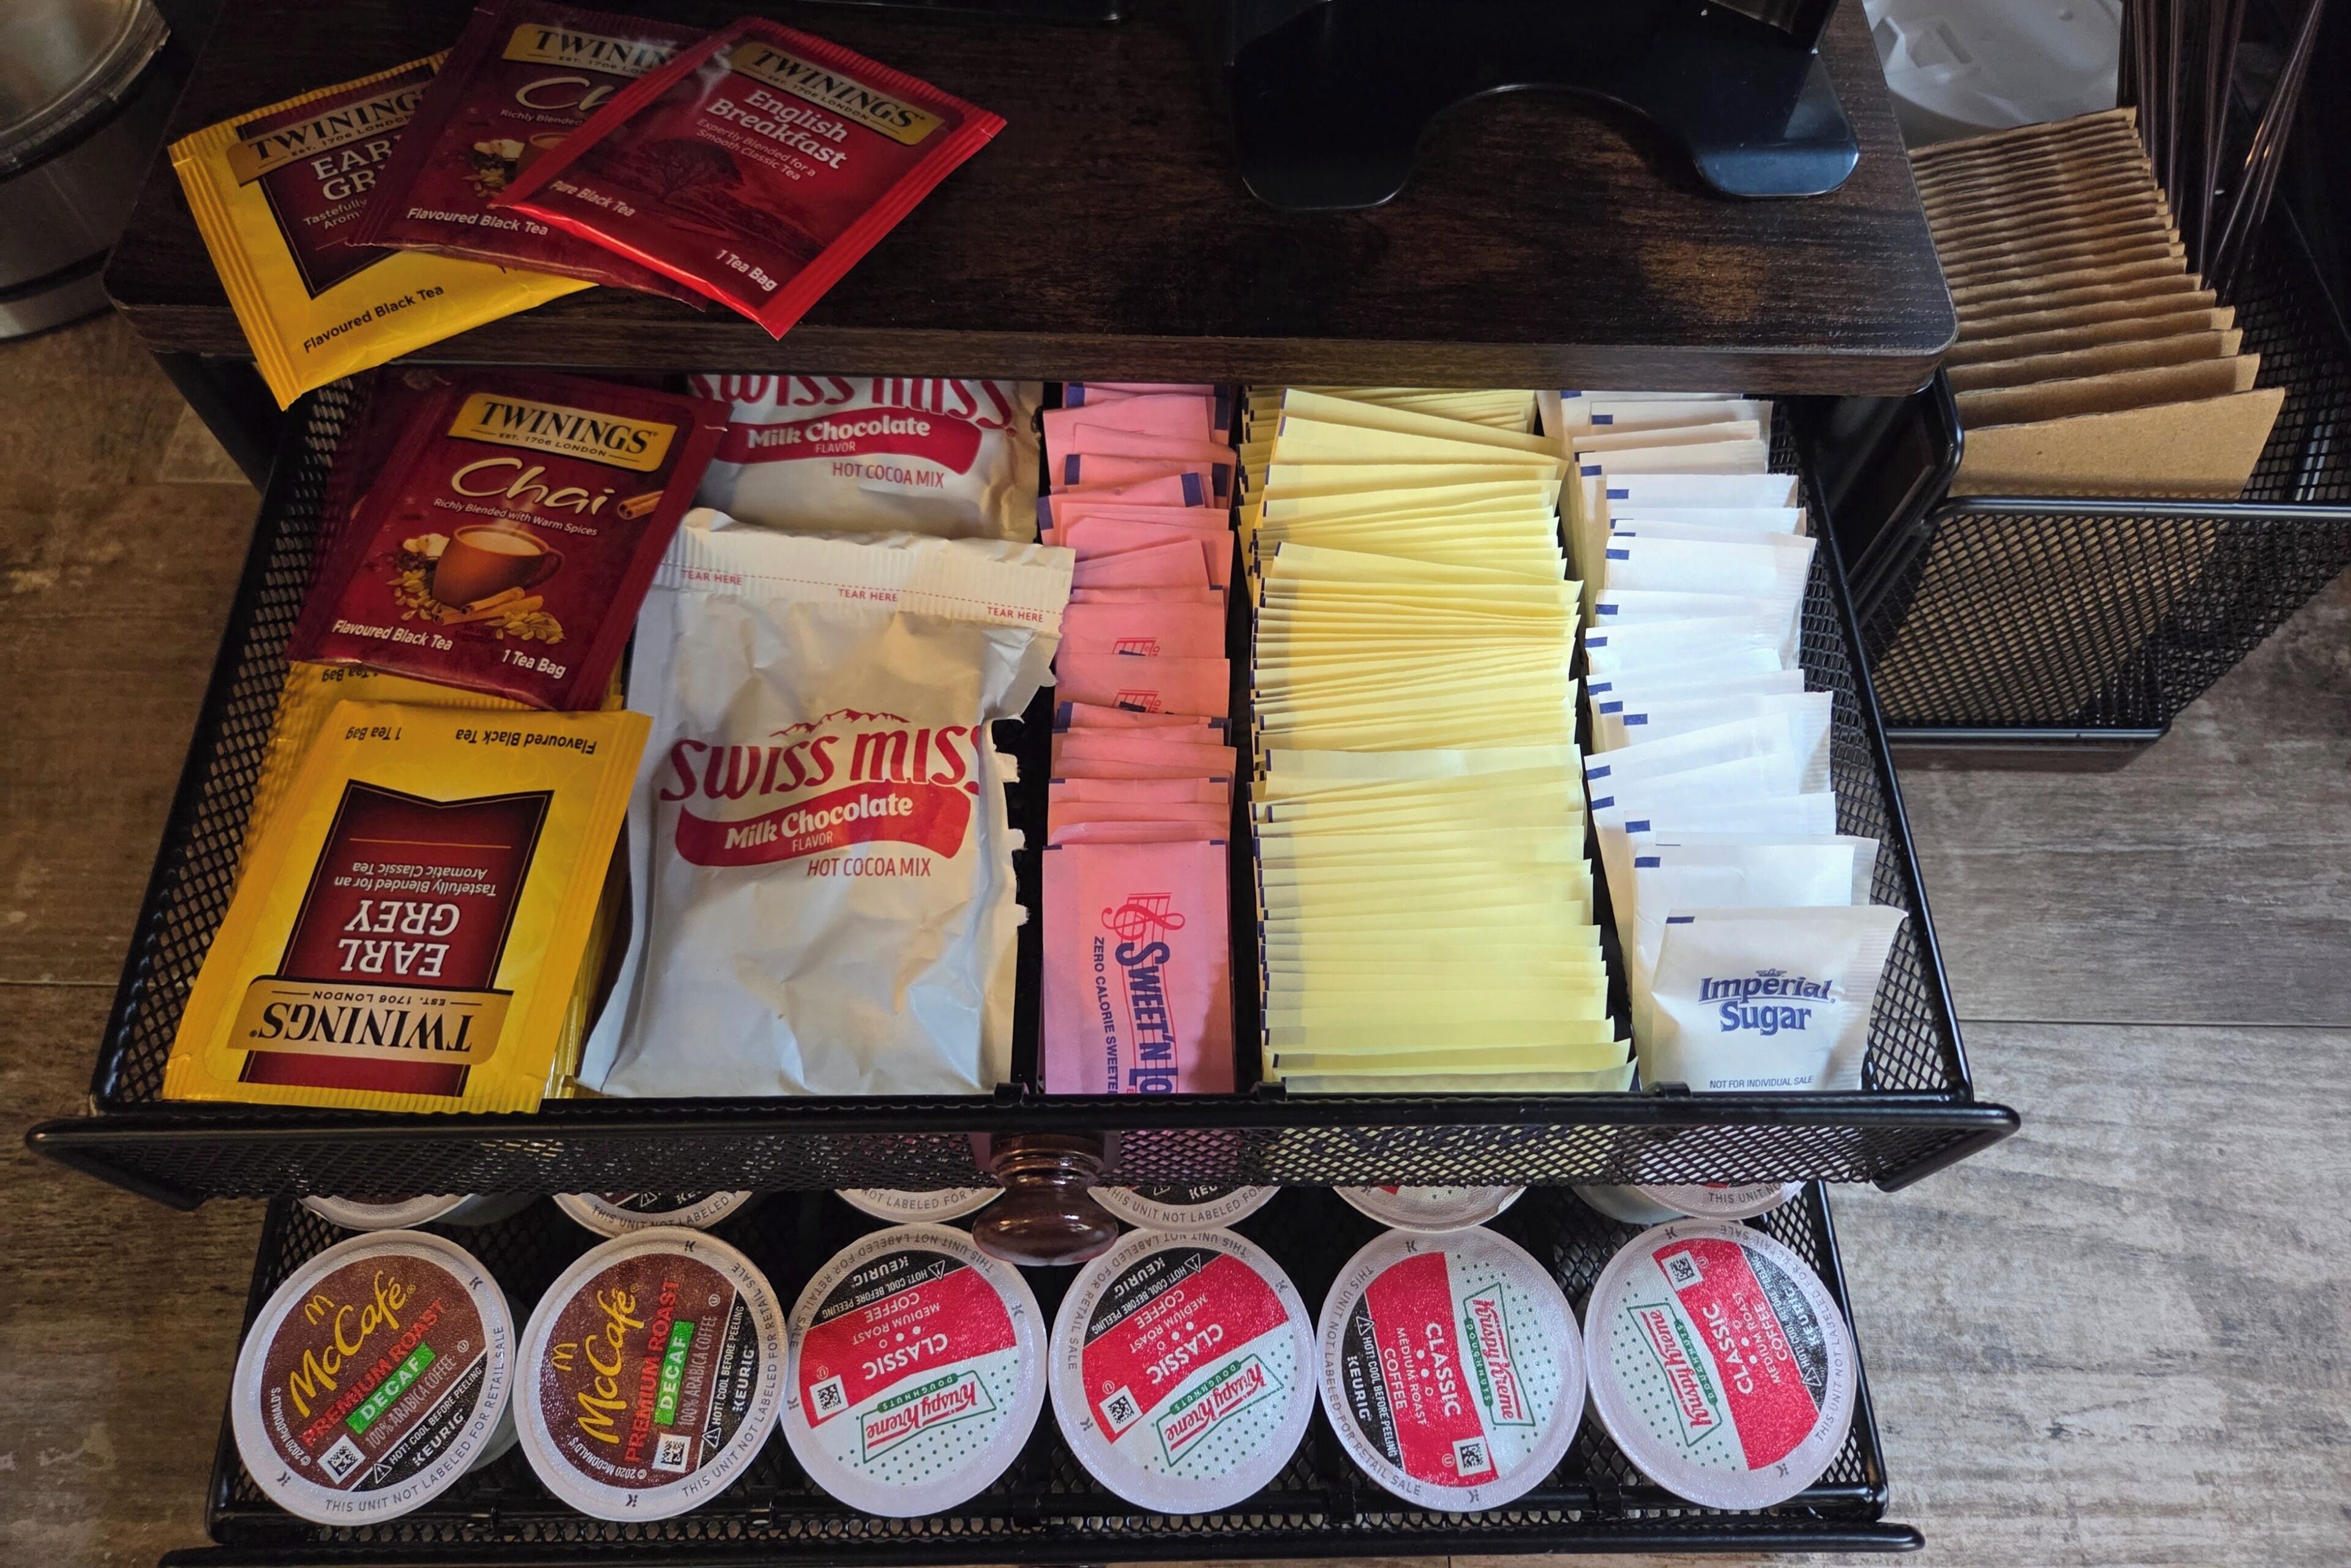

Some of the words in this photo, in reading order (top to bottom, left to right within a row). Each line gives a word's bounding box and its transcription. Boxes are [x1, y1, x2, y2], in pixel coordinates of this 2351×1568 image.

[754, 50, 920, 128] TWININGS
[743, 89, 848, 143] English
[697, 119, 741, 145] Expertly
[743, 136, 789, 161] Blended
[790, 156, 807, 171] for
[807, 168, 816, 177] a
[707, 98, 847, 169] Breakfast
[697, 130, 740, 150] Smooth
[740, 146, 779, 170] Classic
[781, 165, 801, 181] Tea
[551, 181, 578, 195] Pure
[577, 189, 613, 208] Black
[613, 201, 636, 217] Tea
[407, 208, 479, 224] Flavoured
[481, 216, 521, 231] Black
[525, 222, 549, 235] Tea
[716, 250, 727, 260] 1
[726, 255, 749, 273] Tea
[749, 267, 778, 292] Bag
[304, 312, 372, 353] Flavoured
[375, 296, 416, 318] Black
[418, 287, 444, 300] Tea
[479, 402, 652, 454] TWININGS
[748, 429, 801, 449] Milk
[806, 415, 931, 441] Chocolate
[524, 436, 552, 446] 1706
[556, 442, 607, 456] LONDON
[816, 441, 856, 453] FLAVOR
[452, 457, 615, 515] Chai
[832, 462, 863, 476] HOT
[866, 464, 913, 485] COCOA
[916, 471, 944, 488] MIX
[434, 498, 464, 515] Richly
[465, 503, 508, 518] Blended
[509, 511, 531, 522] with
[533, 515, 563, 530] Warm
[564, 523, 598, 536] Spices
[681, 569, 711, 582] TEAR
[714, 573, 743, 586] HERE
[838, 588, 866, 600] TEAR
[868, 590, 898, 602] HERE
[987, 606, 1014, 619] TEAR
[1017, 610, 1043, 623] HERE
[332, 620, 394, 640] Flavoured
[392, 627, 428, 646] Black
[430, 634, 453, 651] Tea
[502, 649, 509, 662] 1
[512, 651, 533, 669] Tea
[537, 658, 566, 679] Bag
[345, 726, 367, 740] Bag
[371, 727, 392, 740] Tea
[394, 727, 402, 740] 1
[456, 729, 478, 742] Tea
[481, 730, 522, 746] Black
[524, 733, 597, 754] Flavoured
[725, 824, 778, 850] Milk
[781, 793, 913, 838] Chocolate
[792, 830, 834, 852] FLAVOR
[334, 877, 350, 887] an
[353, 862, 375, 875] Tea
[354, 877, 372, 889] for
[378, 863, 424, 878] Classic
[426, 866, 487, 880] Aromatic
[807, 860, 840, 877] HOT
[844, 858, 896, 877] COCOA
[899, 858, 931, 877] MIX
[375, 877, 430, 893] Blended
[432, 880, 497, 895] Tastefully
[344, 899, 460, 936] GREY
[338, 939, 451, 977] EARL
[1093, 936, 1104, 972] ZERO
[313, 991, 373, 1001] LONDON
[380, 996, 411, 1005] 1706
[1095, 976, 1115, 1033] CALORIE
[1698, 977, 1833, 1003] Imperial
[258, 1002, 474, 1052] TWININGS
[1720, 1001, 1811, 1036] Sugar
[1129, 1067, 1179, 1093] LO
[1746, 1078, 1792, 1087] INDIVIDUAL
[1794, 1076, 1813, 1084] SALE
[1132, 1200, 1160, 1220] UNIT
[1163, 1211, 1185, 1222] NOT
[1190, 1201, 1241, 1223] LABELED
[887, 1277, 906, 1289] COOL
[908, 1269, 928, 1283] HOT!
[822, 1296, 854, 1318] PEELING
[855, 1285, 885, 1303] BEFORE
[865, 1292, 920, 1323] COFFEE
[1134, 1289, 1185, 1329] COFFEE
[892, 1302, 940, 1327] MEDIUM
[1164, 1295, 1208, 1329] MEDIUM
[1733, 1291, 1759, 1332] ROAST
[290, 1270, 407, 1418] McCafé
[493, 1325, 504, 1359] SALE
[853, 1321, 890, 1345] ROAST
[1130, 1326, 1163, 1354] ROAST
[1702, 1304, 1754, 1395] CLASSIC
[1753, 1304, 1788, 1362] COFFEE
[578, 1288, 644, 1444] McCafé
[862, 1332, 948, 1381] CLASSIC
[1146, 1323, 1224, 1384] CLASSIC
[1425, 1322, 1461, 1417] CLASSIC
[1753, 1334, 1781, 1384] MEDIUM
[302, 1358, 394, 1447] PREMIUM
[389, 1300, 445, 1362] ROAST
[361, 1356, 422, 1420] DECAF
[487, 1357, 504, 1409] RETAIL
[625, 1356, 659, 1463] PREMIUM
[648, 1281, 680, 1352] ROAST
[661, 1335, 686, 1411] DECAF
[1384, 1348, 1407, 1411] COFFEE
[1395, 1327, 1415, 1377] MEDIUM
[1409, 1377, 1426, 1426] ROAST
[366, 1417, 395, 1449] 100%
[392, 1386, 430, 1427] ARABICA
[424, 1354, 457, 1390] COFFEE
[881, 1375, 953, 1410] DOUGHNUTS
[921, 1381, 977, 1422] Krispy
[389, 1443, 410, 1465] HOT!
[410, 1424, 431, 1446] COOL
[429, 1396, 456, 1426] BEFORE
[454, 1366, 482, 1399] PEELING
[470, 1412, 490, 1442] FOR
[865, 1403, 920, 1442] Kreme
[1165, 1400, 1218, 1446] Kreme
[423, 1443, 471, 1489] LABELED
[326, 1499, 353, 1513] THIS
[359, 1498, 388, 1512] UNIT
[394, 1485, 419, 1504] NOT
